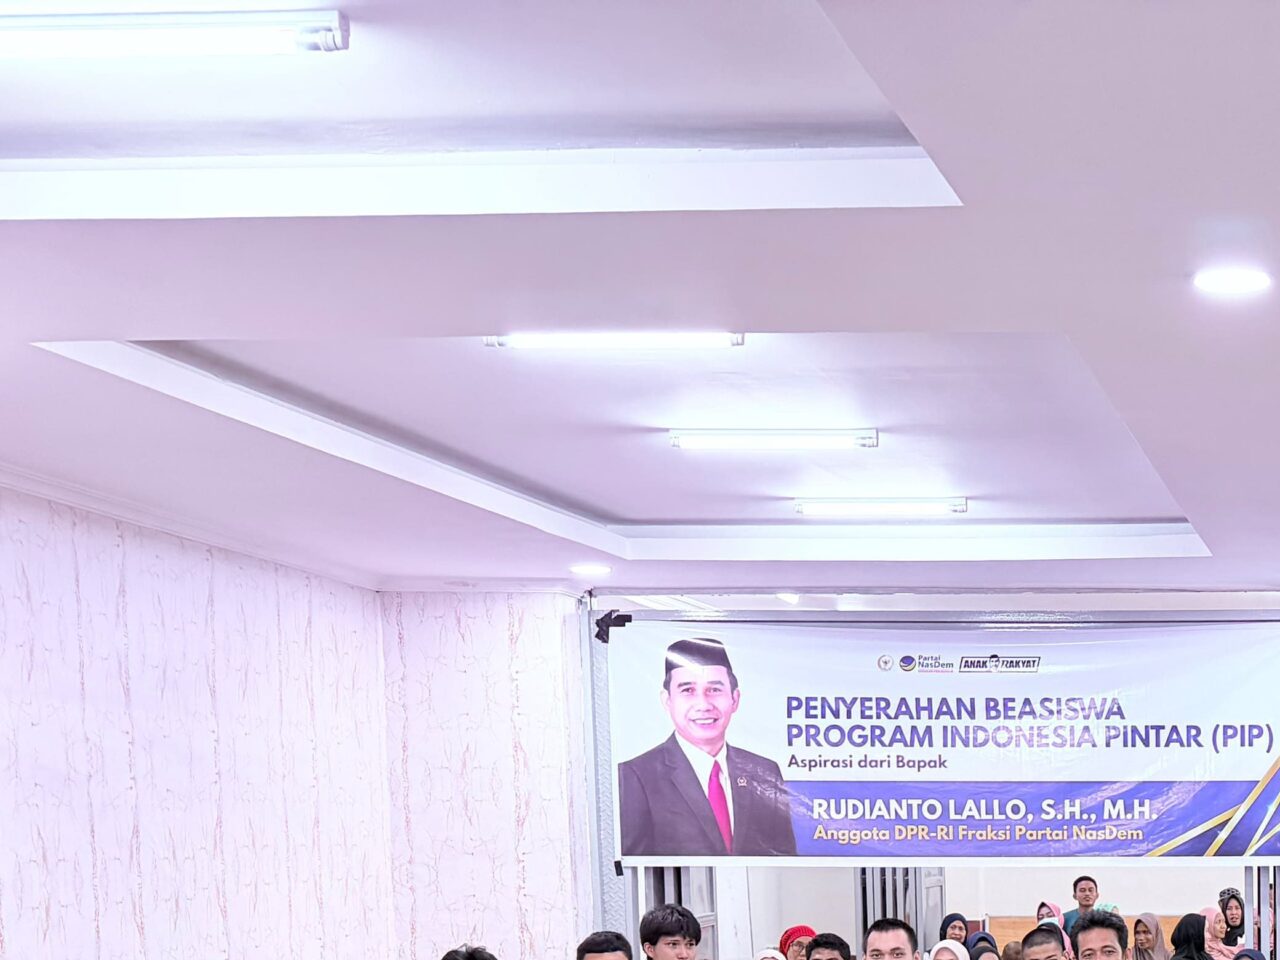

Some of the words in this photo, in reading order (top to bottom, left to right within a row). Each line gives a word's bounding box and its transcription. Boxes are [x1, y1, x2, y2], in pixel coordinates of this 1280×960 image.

[918, 661, 954, 669] NasDem
[963, 659, 989, 669] ANAK
[1001, 659, 1037, 669] RAKYAT
[786, 697, 976, 720] PENYERAHAN
[985, 697, 1126, 720] BEASISWA
[787, 724, 934, 747] PROGRAM
[942, 724, 1098, 748] INDONESIA
[1105, 725, 1204, 748] PINTAR
[1212, 723, 1274, 753] (PIP)
[787, 754, 853, 772] Aspirasi
[858, 754, 891, 769] dari
[896, 754, 947, 772] Bapak
[813, 798, 943, 820] RUDIANTO
[949, 799, 1034, 823] LALLO,
[1040, 799, 1097, 823] S.H.,
[1103, 799, 1158, 820] M.H.
[813, 825, 890, 845] Anggota
[895, 825, 953, 840] DPR-RI
[958, 825, 1010, 841] Fraksi
[1015, 825, 1068, 841] Partai
[1072, 825, 1143, 840] NasDem
